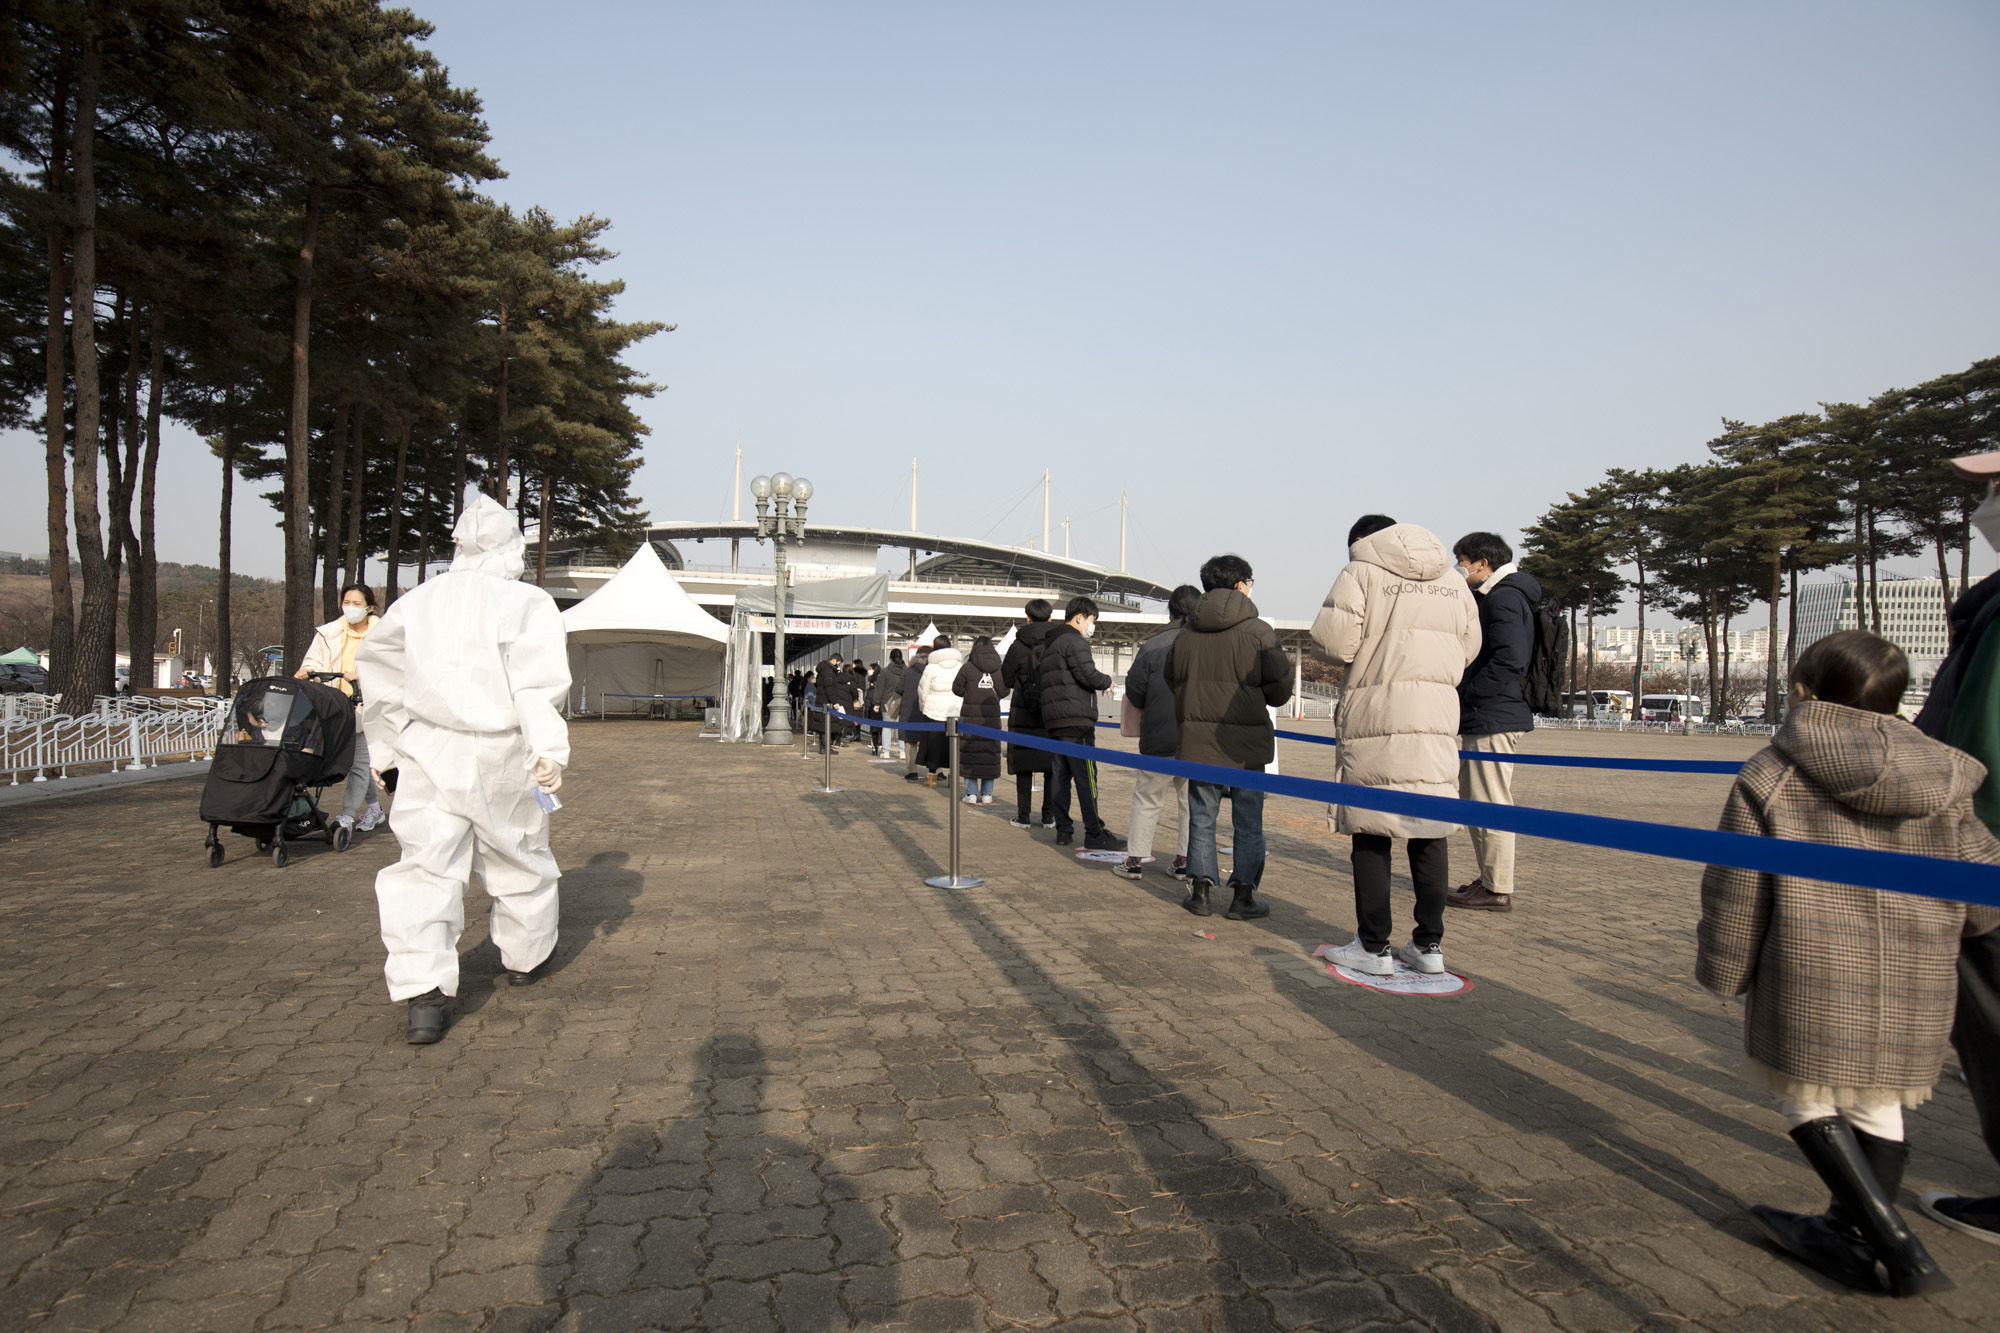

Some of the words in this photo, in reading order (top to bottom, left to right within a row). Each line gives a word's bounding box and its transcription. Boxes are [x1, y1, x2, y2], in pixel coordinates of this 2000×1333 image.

[1382, 583, 1423, 597] KOLON
[1427, 585, 1459, 599] SPORT
[765, 619, 790, 628] 서시
[794, 620, 831, 629] 코로나19
[835, 621, 859, 629] 검사소
